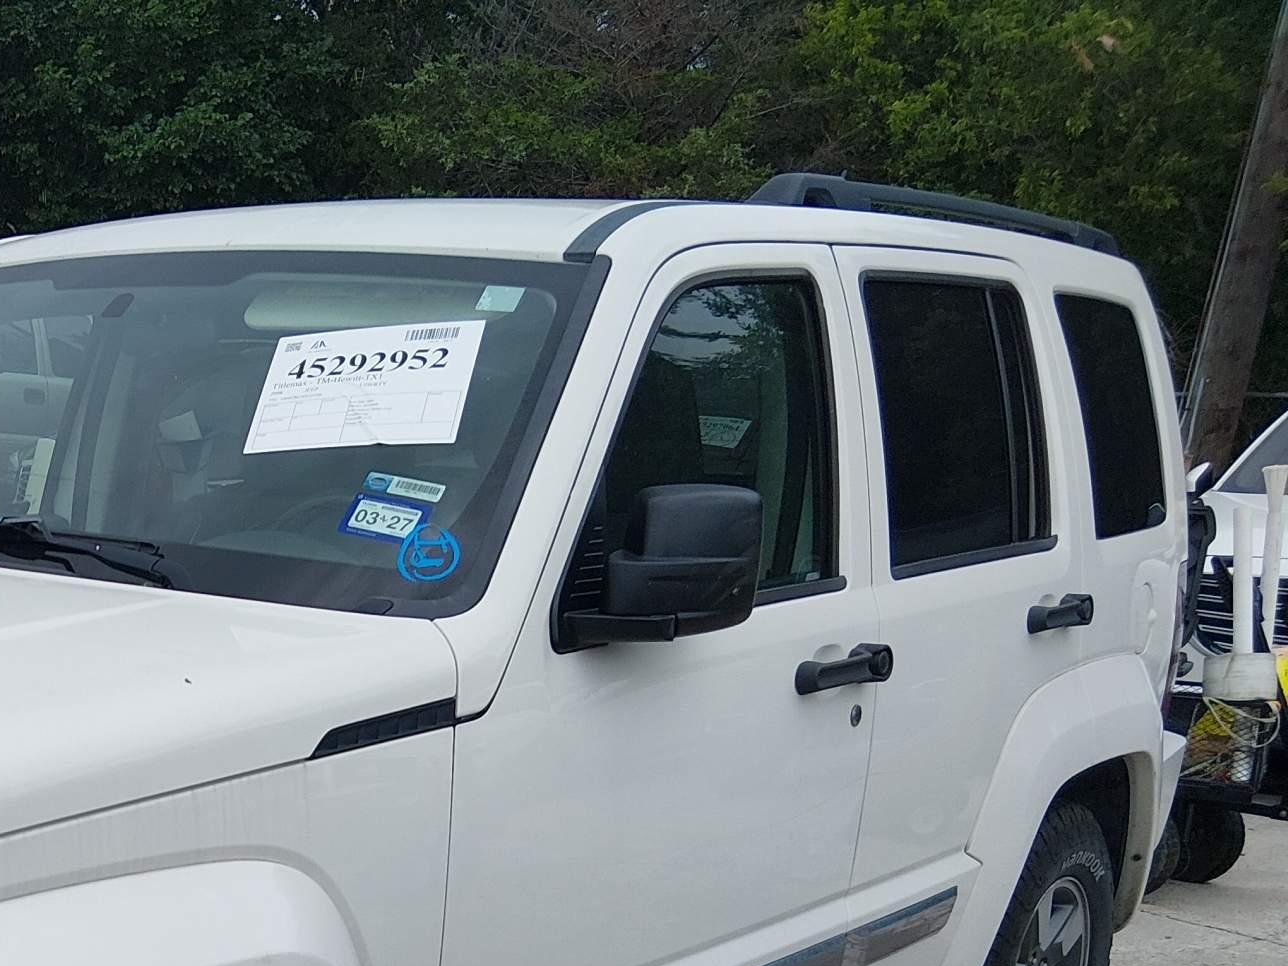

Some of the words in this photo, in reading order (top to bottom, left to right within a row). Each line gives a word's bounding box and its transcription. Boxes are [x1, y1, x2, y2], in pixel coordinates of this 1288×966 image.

[288, 348, 449, 379] 45292952
[355, 509, 380, 525] 03
[386, 515, 415, 531] 27
